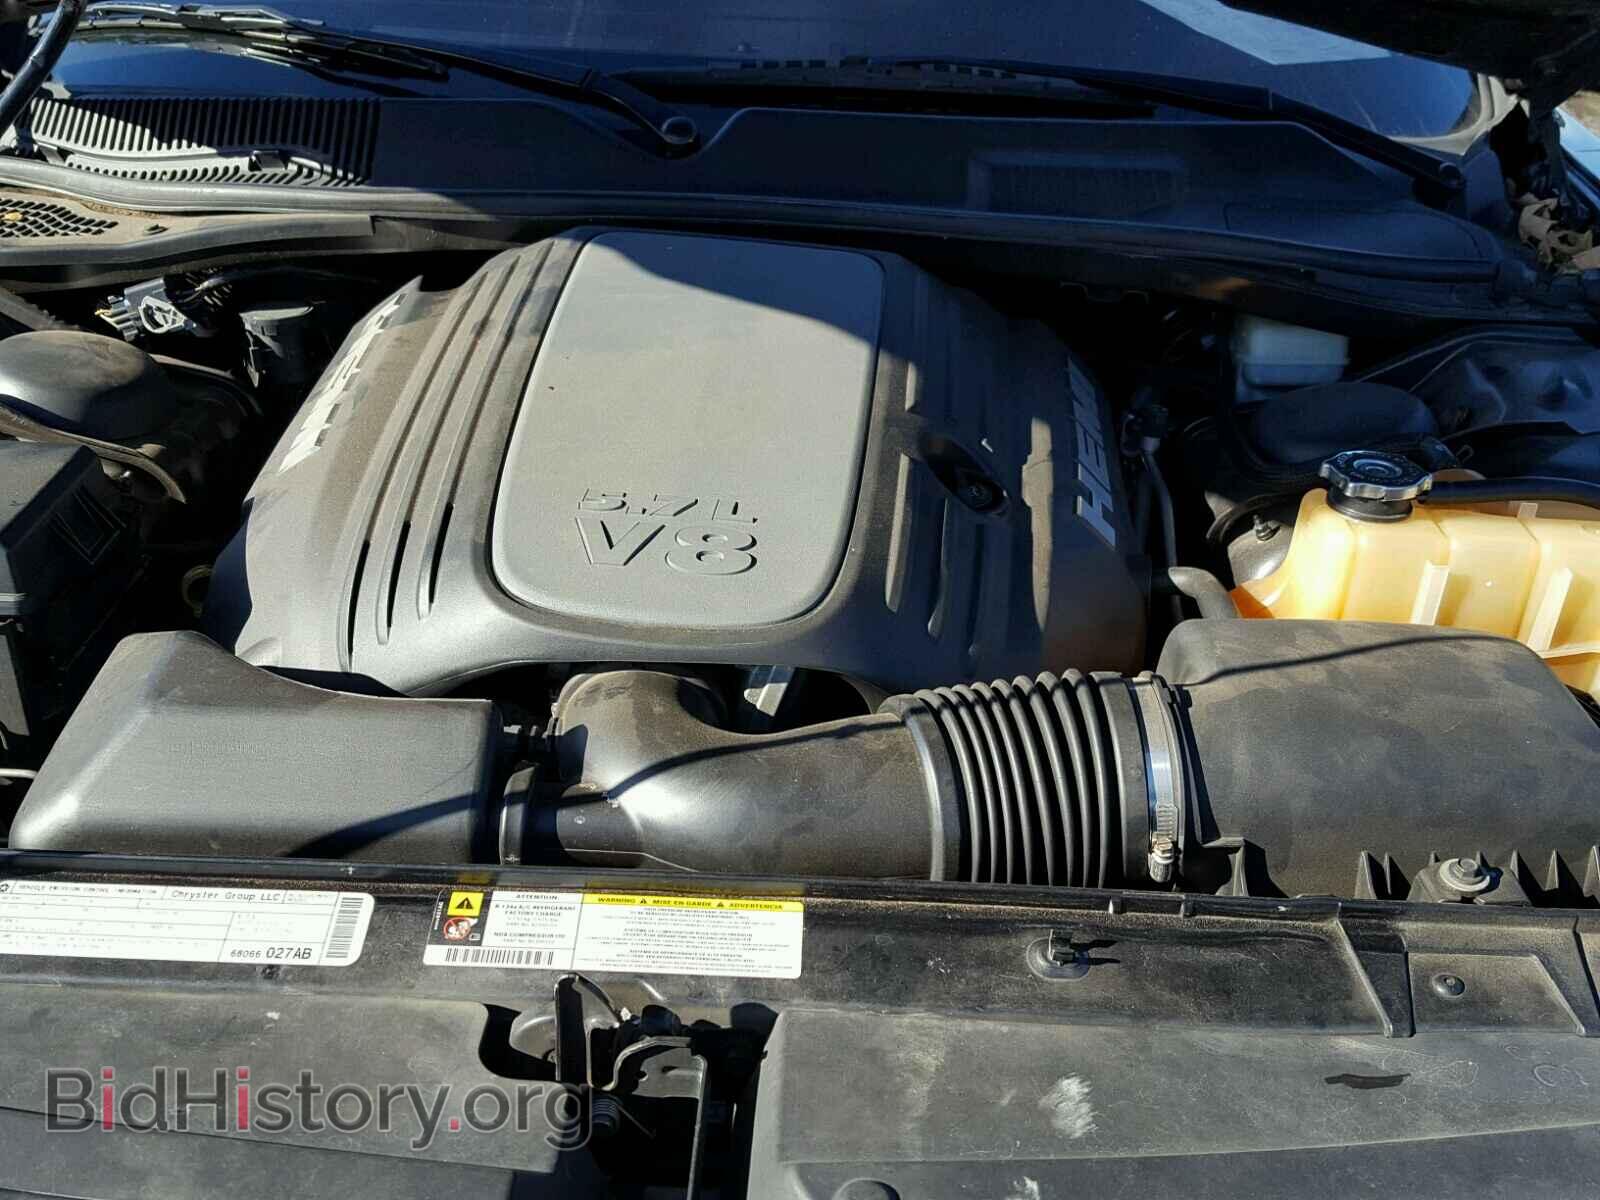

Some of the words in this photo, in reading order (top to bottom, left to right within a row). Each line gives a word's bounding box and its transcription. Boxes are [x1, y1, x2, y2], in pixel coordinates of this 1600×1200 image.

[574, 515, 759, 577] V8
[224, 891, 257, 904] Group
[260, 892, 281, 902] LLC
[597, 896, 637, 904] WARNING
[728, 902, 784, 911] ADVERTENCIA
[265, 946, 313, 960] 027AB
